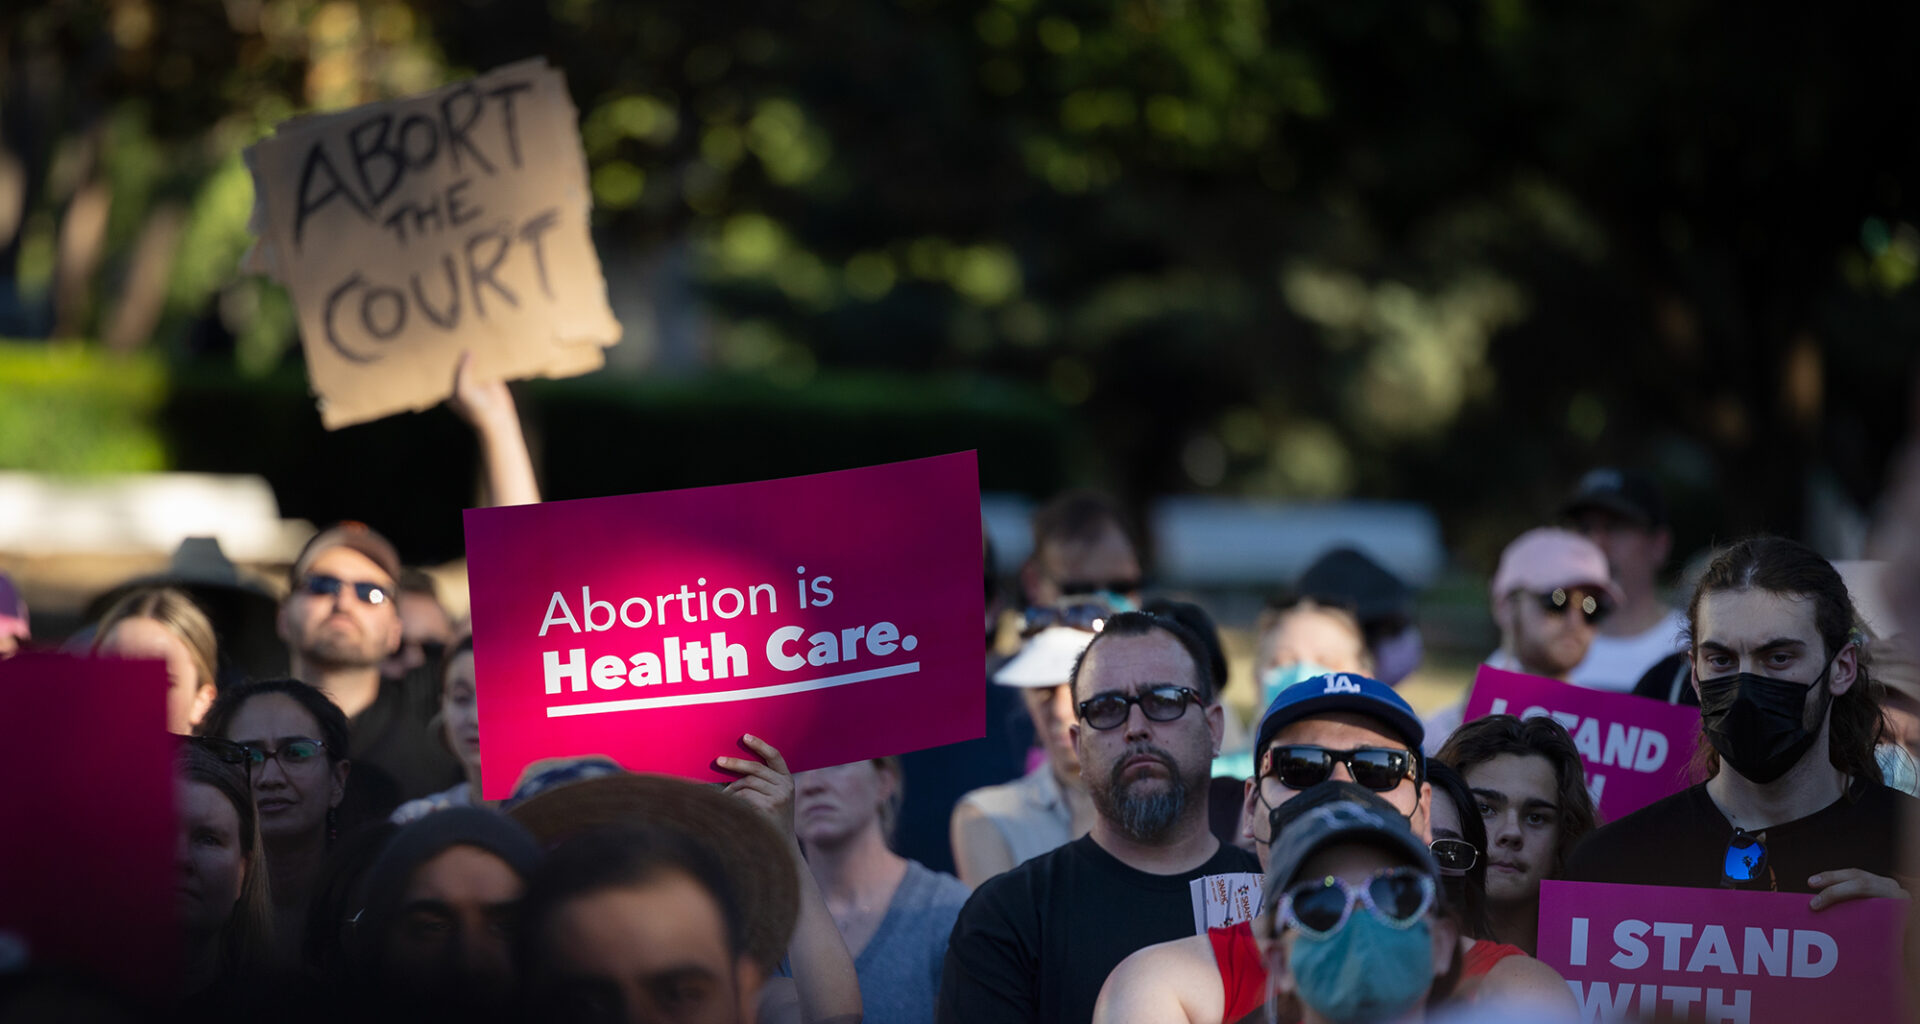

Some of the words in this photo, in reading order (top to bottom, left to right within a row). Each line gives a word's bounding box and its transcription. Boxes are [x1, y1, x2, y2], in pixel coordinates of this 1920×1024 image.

[294, 81, 533, 244] ABORT
[382, 179, 483, 244] THE
[324, 208, 562, 363] COURT
[538, 577, 777, 637] Abortion
[797, 565, 834, 610] is
[542, 631, 749, 695] Health
[765, 620, 919, 672] Care.
[1323, 673, 1361, 694] LA
[1569, 917, 1589, 966] I
[1609, 919, 1839, 979] STAND
[1566, 980, 1752, 1024] WITH
